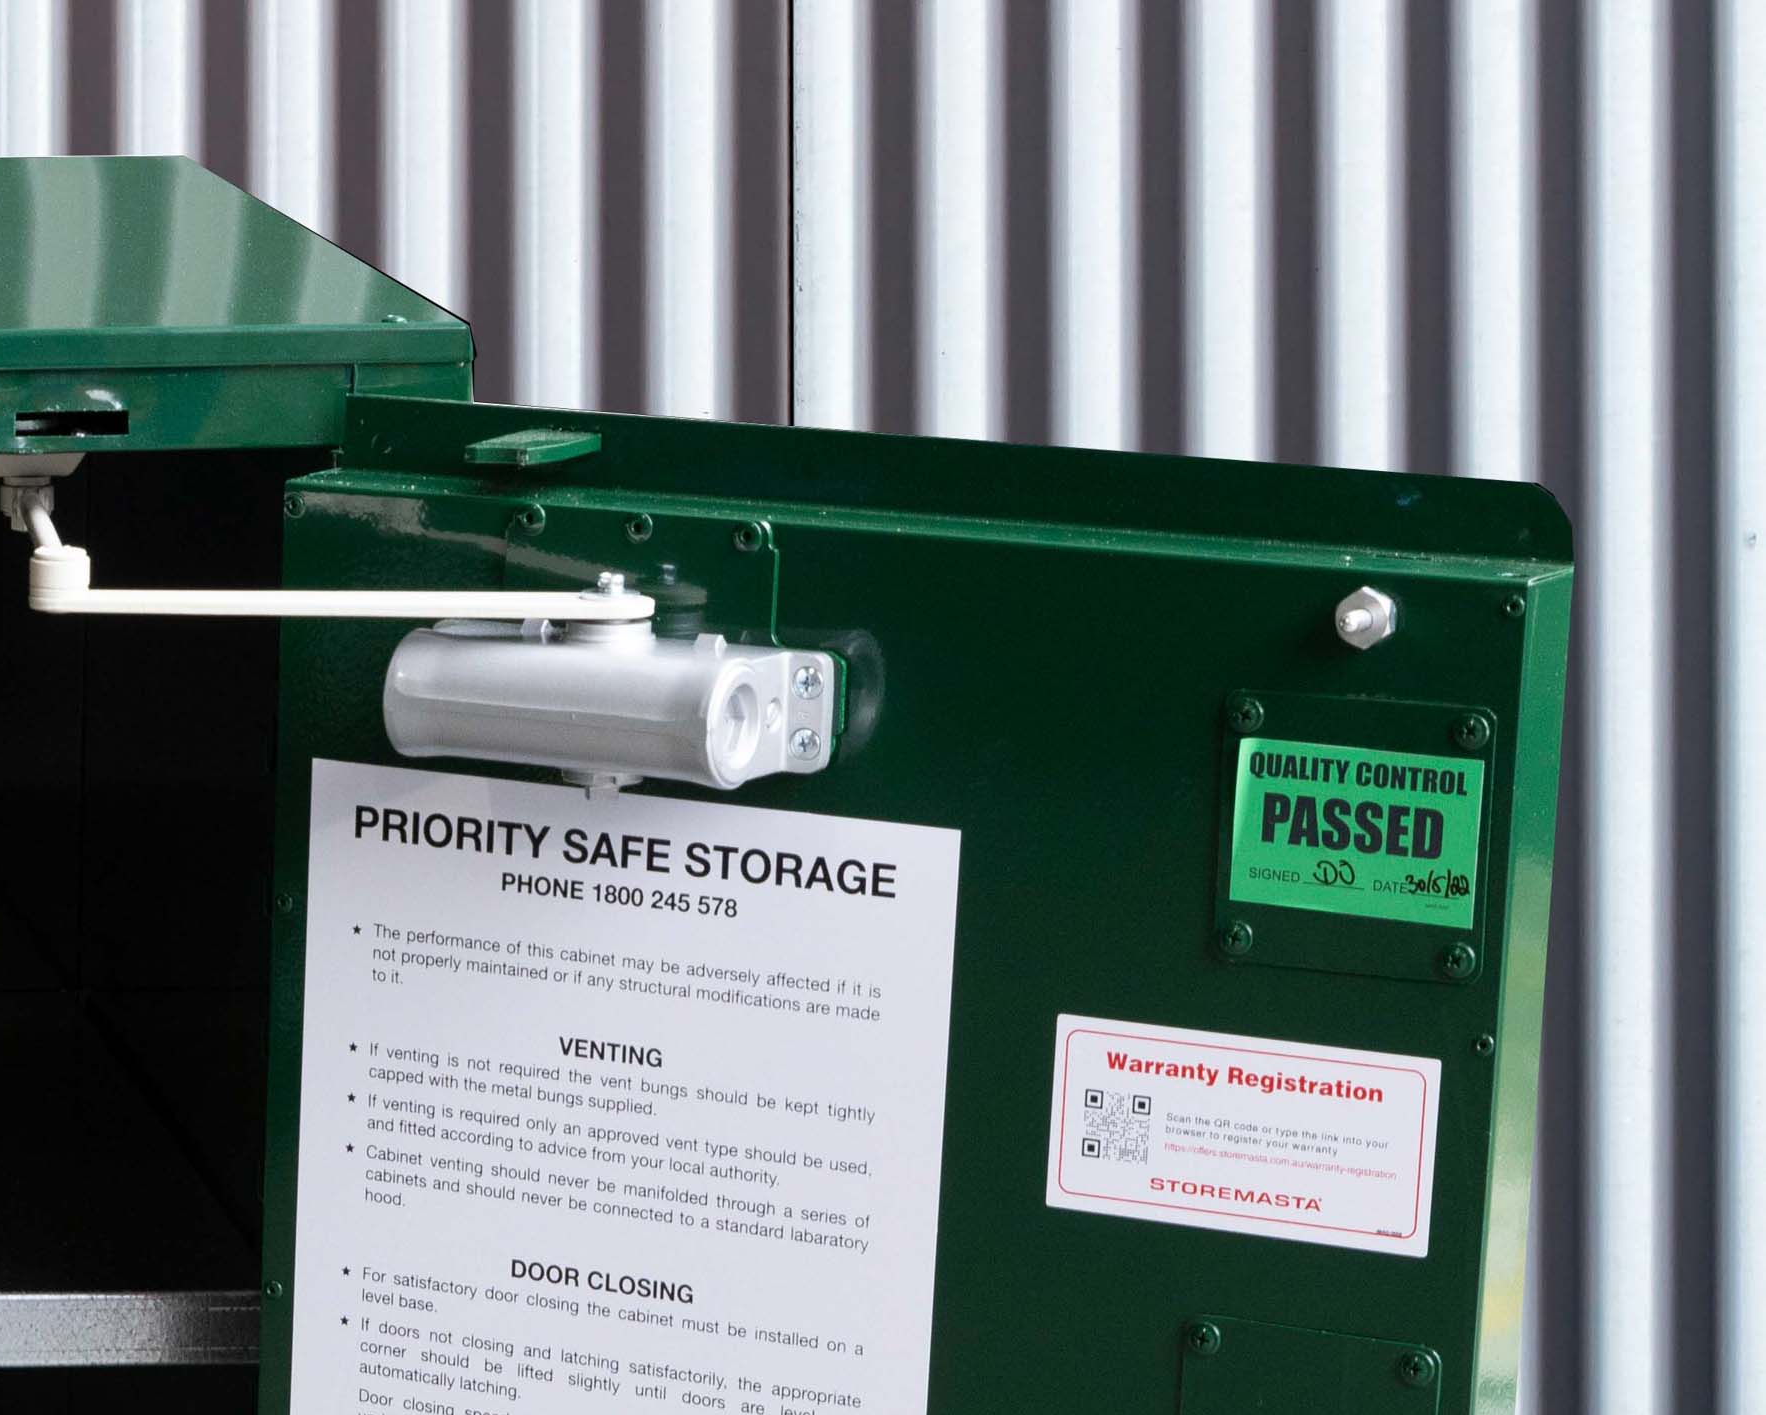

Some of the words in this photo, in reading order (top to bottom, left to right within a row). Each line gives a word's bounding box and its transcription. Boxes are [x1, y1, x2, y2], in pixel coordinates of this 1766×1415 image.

[1250, 752, 1350, 784] QUALITY
[1356, 762, 1467, 796] CONTROL
[1262, 792, 1444, 859] PASSED
[354, 804, 551, 860] PRIORITY
[562, 827, 672, 875] SAFE
[684, 841, 897, 899] STORAGE
[1249, 867, 1300, 882] SIGNED
[501, 871, 585, 901] PHONE
[591, 882, 644, 908] 1800
[650, 889, 691, 913] 245
[697, 895, 738, 919] 578
[1373, 880, 1407, 894] DATE
[372, 968, 387, 983] to
[391, 969, 403, 985] it.
[372, 947, 396, 962] not
[401, 951, 462, 973] properly
[466, 959, 549, 981] maintained
[552, 970, 569, 983] or
[573, 970, 583, 985] if
[587, 974, 614, 992] any
[618, 977, 691, 998] structural
[696, 988, 801, 1012] modifications
[805, 1001, 831, 1016] are
[835, 1005, 880, 1022] made
[373, 922, 401, 941] The
[406, 930, 501, 953] performance
[506, 940, 522, 955] of
[527, 943, 554, 960] this
[559, 948, 615, 967] cabinet
[622, 957, 655, 975] may
[660, 959, 680, 975] be
[686, 963, 761, 988] adversely
[766, 972, 831, 993] affected
[837, 980, 846, 995] if
[852, 983, 861, 997] it
[868, 987, 882, 999] is
[558, 1035, 663, 1069] VENTING
[368, 1067, 424, 1085] capped
[428, 1072, 459, 1089] with
[463, 1076, 487, 1094] the
[491, 1083, 533, 1100] metal
[537, 1085, 584, 1109] bungs
[587, 1096, 657, 1116] supplied.
[369, 1042, 379, 1057] If
[386, 1047, 440, 1069] venting
[447, 1055, 460, 1068] is
[467, 1058, 491, 1072] not
[499, 1063, 560, 1081] required
[568, 1068, 593, 1085] the
[600, 1076, 632, 1091] vent
[640, 1077, 688, 1101] bungs
[696, 1087, 748, 1106] should
[756, 1093, 776, 1110] be
[784, 1097, 819, 1117] kept
[827, 1103, 876, 1125] tightly
[1107, 1052, 1219, 1086] Warranty
[1228, 1066, 1384, 1103] Registration
[368, 1093, 378, 1108] If
[382, 1098, 436, 1120] venting
[441, 1103, 454, 1119] is
[459, 1109, 520, 1128] required
[525, 1117, 557, 1137] only
[563, 1123, 581, 1137] an
[587, 1126, 660, 1147] approved
[665, 1137, 698, 1153] vent
[704, 1140, 739, 1159] type
[744, 1146, 797, 1166] should
[803, 1152, 823, 1169] be
[1165, 1125, 1205, 1137] browser
[1209, 1131, 1219, 1139] to
[1223, 1133, 1261, 1146] register
[1266, 1139, 1287, 1150] your
[1291, 1142, 1337, 1156] warranty
[1166, 1112, 1191, 1123] Scan
[1195, 1115, 1210, 1126] the
[1213, 1118, 1230, 1129] QR
[1234, 1121, 1258, 1132] code
[1262, 1126, 1271, 1134] or
[1275, 1127, 1297, 1140] type
[1301, 1130, 1317, 1139] the
[1321, 1132, 1338, 1142] link
[1342, 1135, 1362, 1145] into
[1366, 1139, 1388, 1151] your
[364, 1186, 405, 1207] hood.
[366, 1144, 423, 1166] Cabinet
[429, 1156, 484, 1178] venting
[490, 1163, 541, 1183] should
[548, 1173, 590, 1190] never
[596, 1176, 616, 1194] be
[623, 1184, 708, 1207] manifolded
[716, 1194, 776, 1219] through
[783, 1206, 793, 1219] a
[800, 1208, 847, 1226] series
[854, 1214, 870, 1229] of
[361, 1287, 394, 1306] level
[398, 1293, 437, 1313] base.
[510, 1258, 580, 1288] DOOR
[586, 1270, 694, 1305] CLOSING
[362, 1266, 387, 1284] For
[393, 1274, 478, 1301] satisfactory
[484, 1286, 519, 1303] door
[526, 1292, 579, 1317] closing
[587, 1301, 611, 1318] the
[618, 1308, 674, 1328] cabinet
[681, 1318, 719, 1335] must
[727, 1322, 747, 1338] be
[754, 1329, 819, 1349] installed
[826, 1340, 847, 1353] on
[854, 1344, 864, 1356] a
[359, 1362, 456, 1391] automatically
[459, 1375, 521, 1402] latching.
[361, 1316, 371, 1332] If
[378, 1320, 420, 1340] doors
[429, 1331, 452, 1345] not
[461, 1334, 514, 1358] closing
[523, 1345, 552, 1361] and
[560, 1348, 619, 1375] latching
[629, 1362, 727, 1391] satisfactorily,
[738, 1376, 762, 1393] the
[771, 1384, 862, 1409] appropriate
